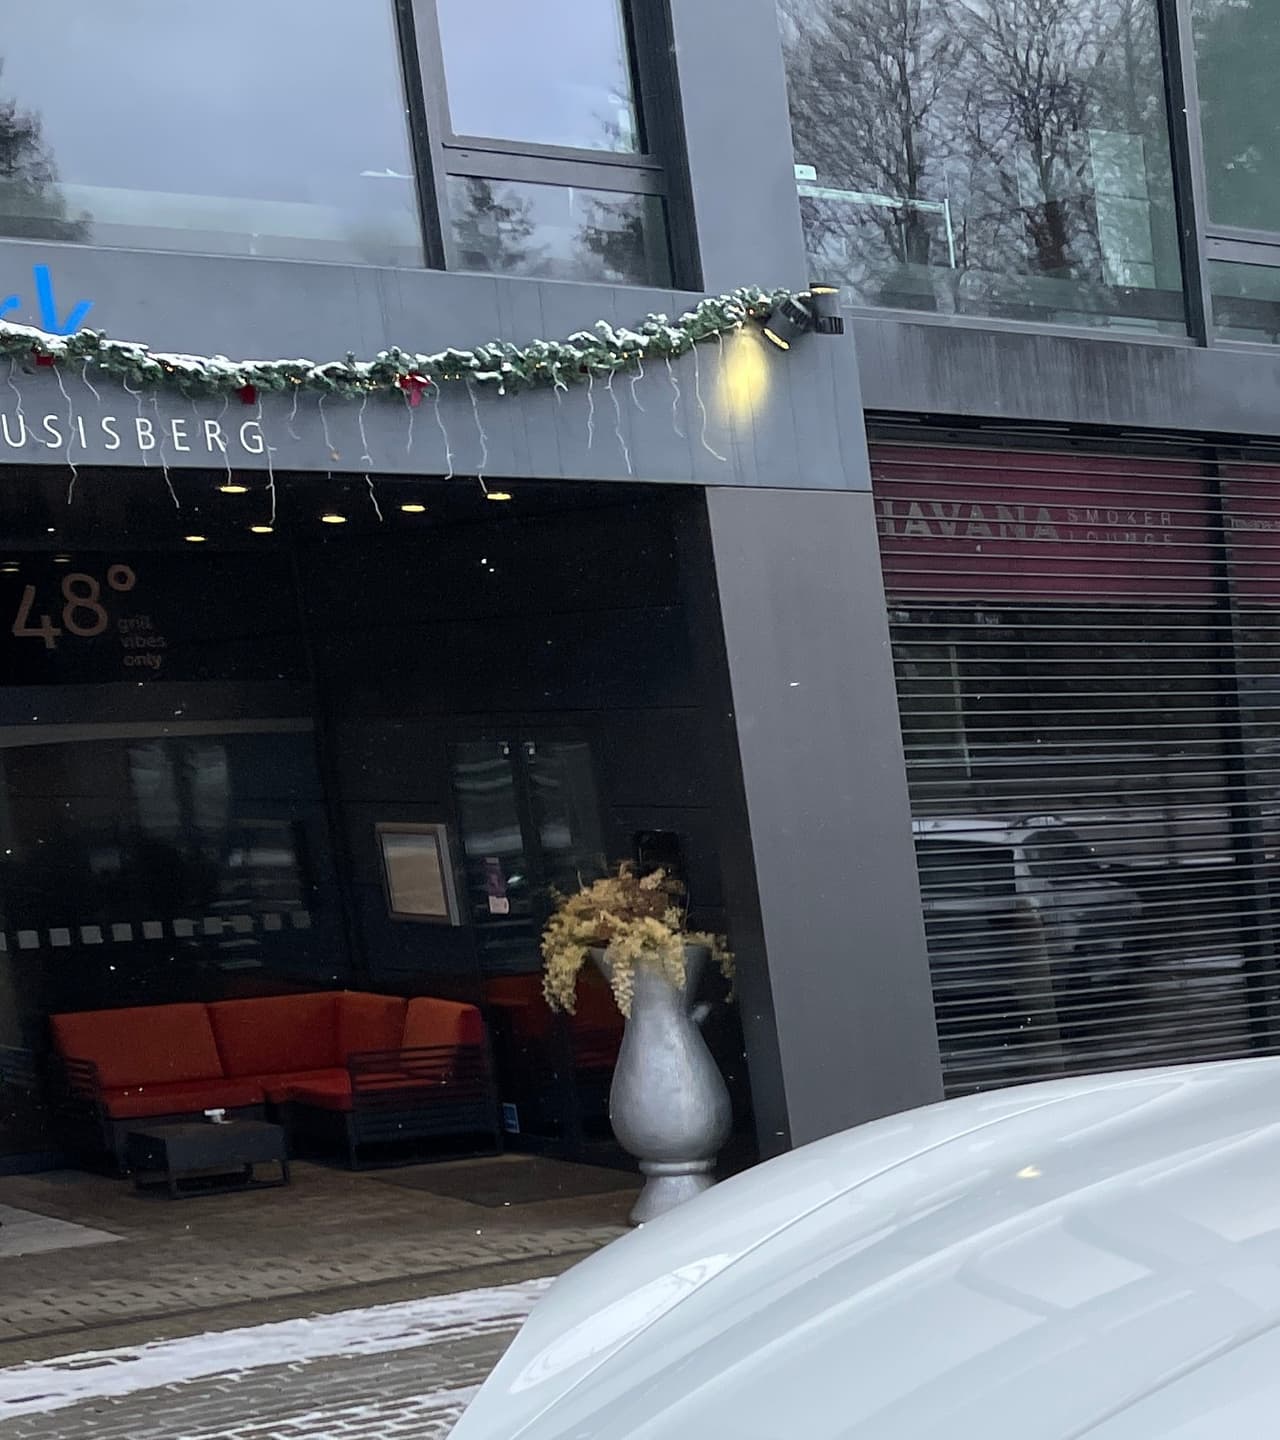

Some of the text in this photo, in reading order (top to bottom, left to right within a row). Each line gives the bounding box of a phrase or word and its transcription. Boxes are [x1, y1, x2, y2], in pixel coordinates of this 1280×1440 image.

[1, 414, 265, 454] USISBERG
[1067, 508, 1172, 526] SMOKER
[123, 653, 163, 670] only
